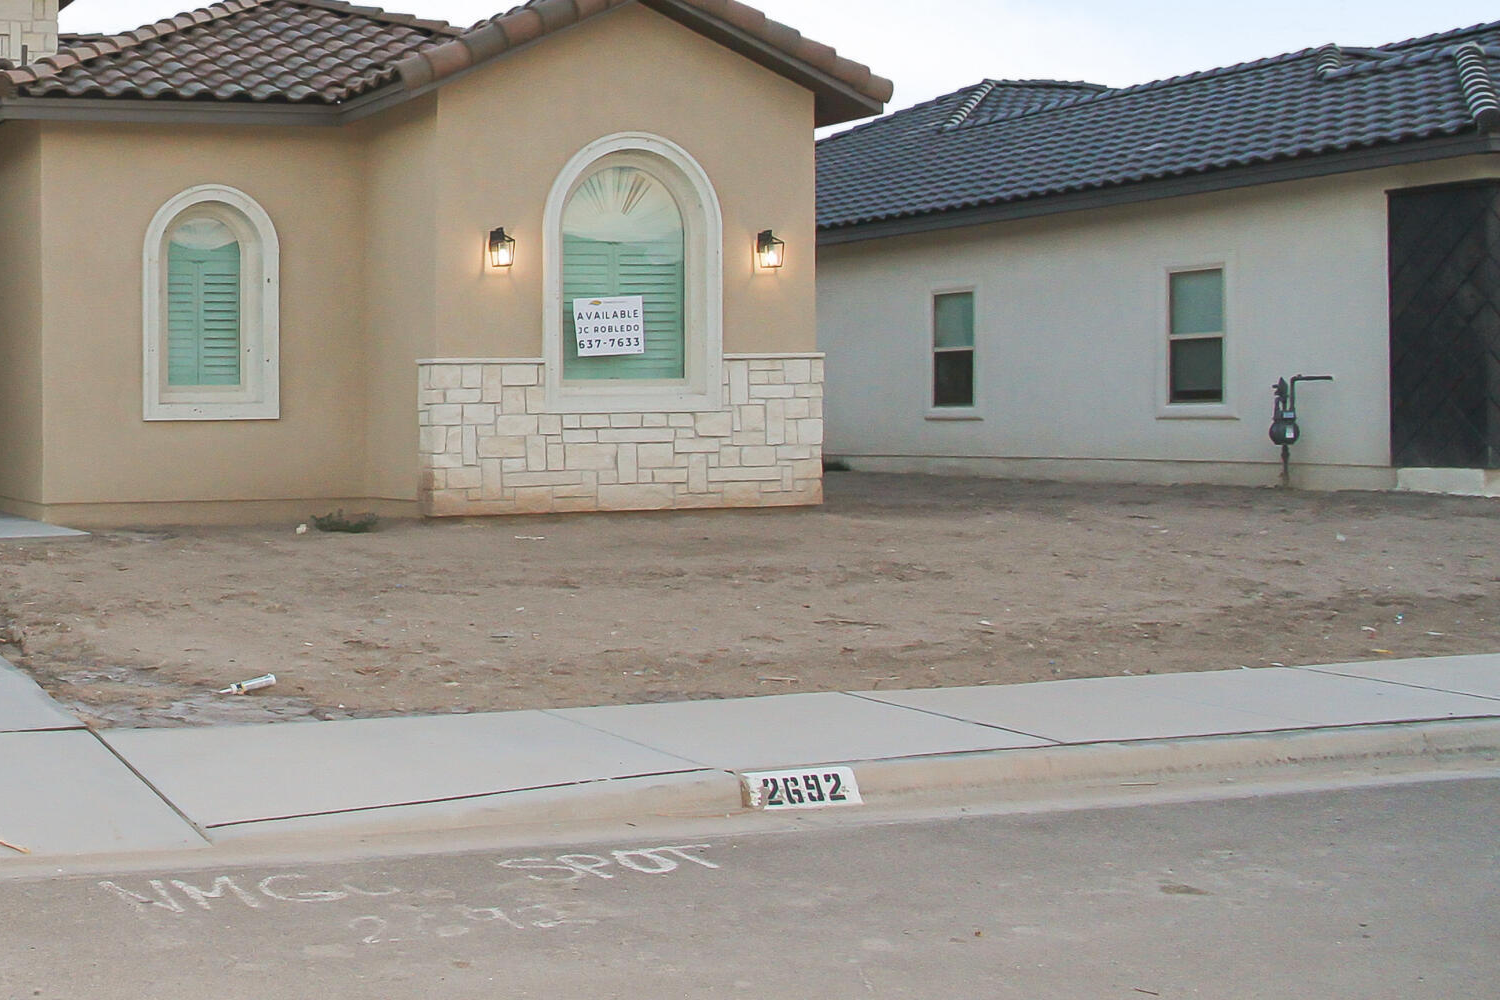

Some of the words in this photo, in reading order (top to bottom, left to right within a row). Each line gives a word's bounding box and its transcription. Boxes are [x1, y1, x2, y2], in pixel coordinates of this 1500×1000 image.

[577, 309, 639, 321] AVAILABLE
[578, 326, 589, 334] JC
[594, 324, 640, 334] ROBLEDO
[578, 337, 640, 349] 637-7633
[762, 773, 846, 806] 2692
[497, 843, 720, 884] SPOT
